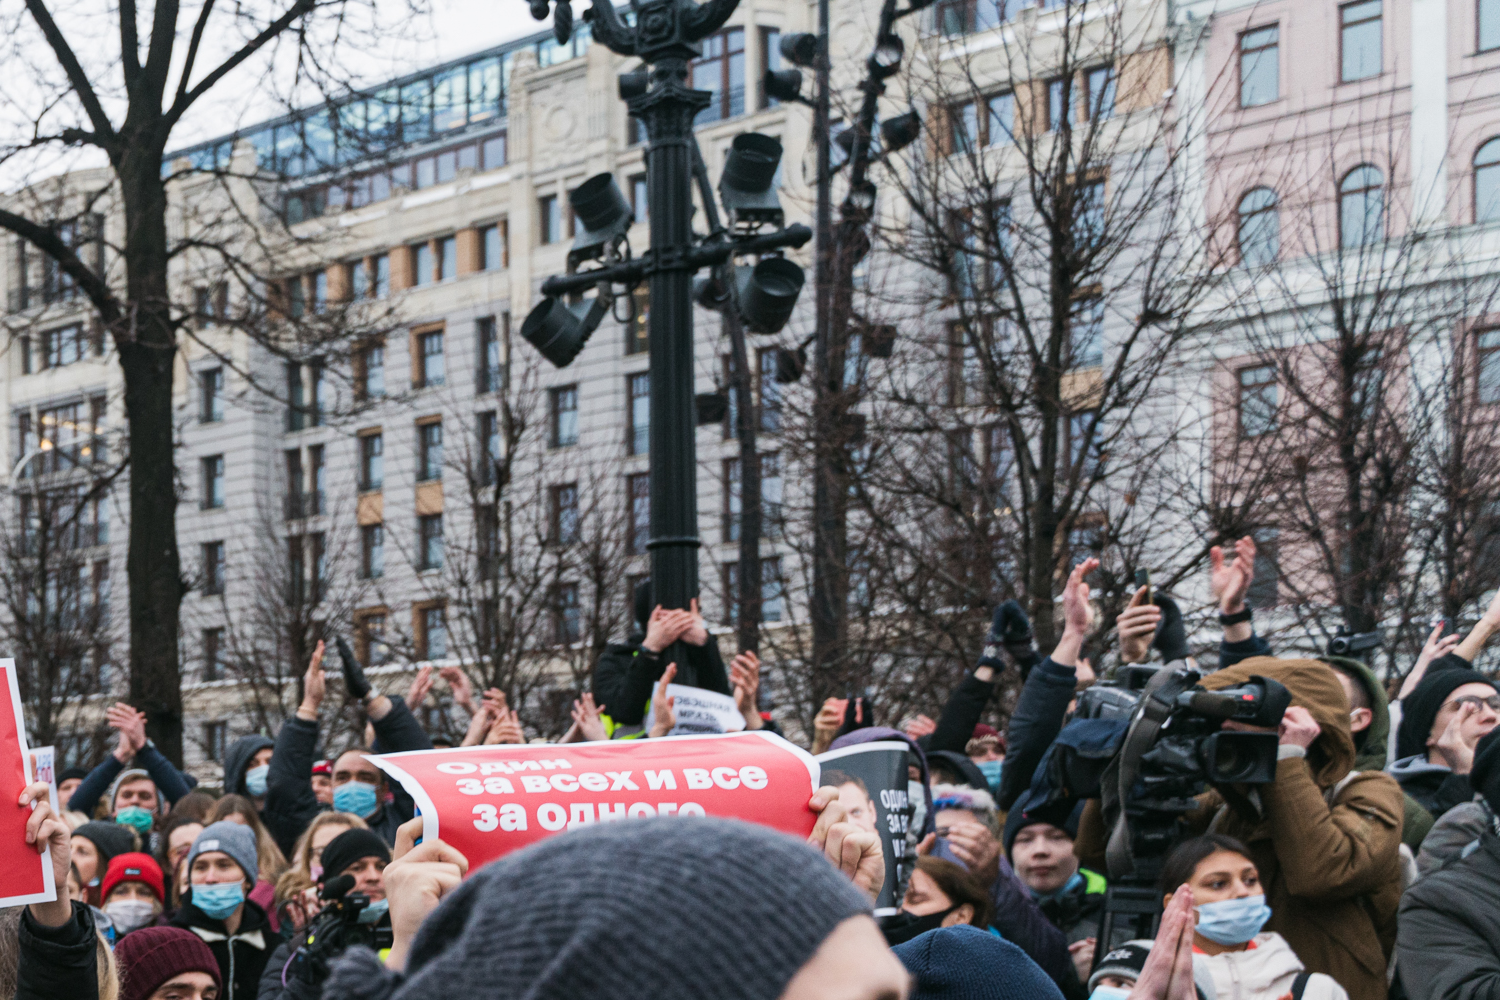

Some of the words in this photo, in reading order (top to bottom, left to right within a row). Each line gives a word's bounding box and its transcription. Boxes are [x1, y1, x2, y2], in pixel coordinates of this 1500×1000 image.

[436, 758, 573, 776] Один
[455, 776, 515, 796] за
[519, 770, 640, 794] всех
[643, 769, 678, 791] и
[682, 765, 769, 791] все
[471, 802, 528, 833] за
